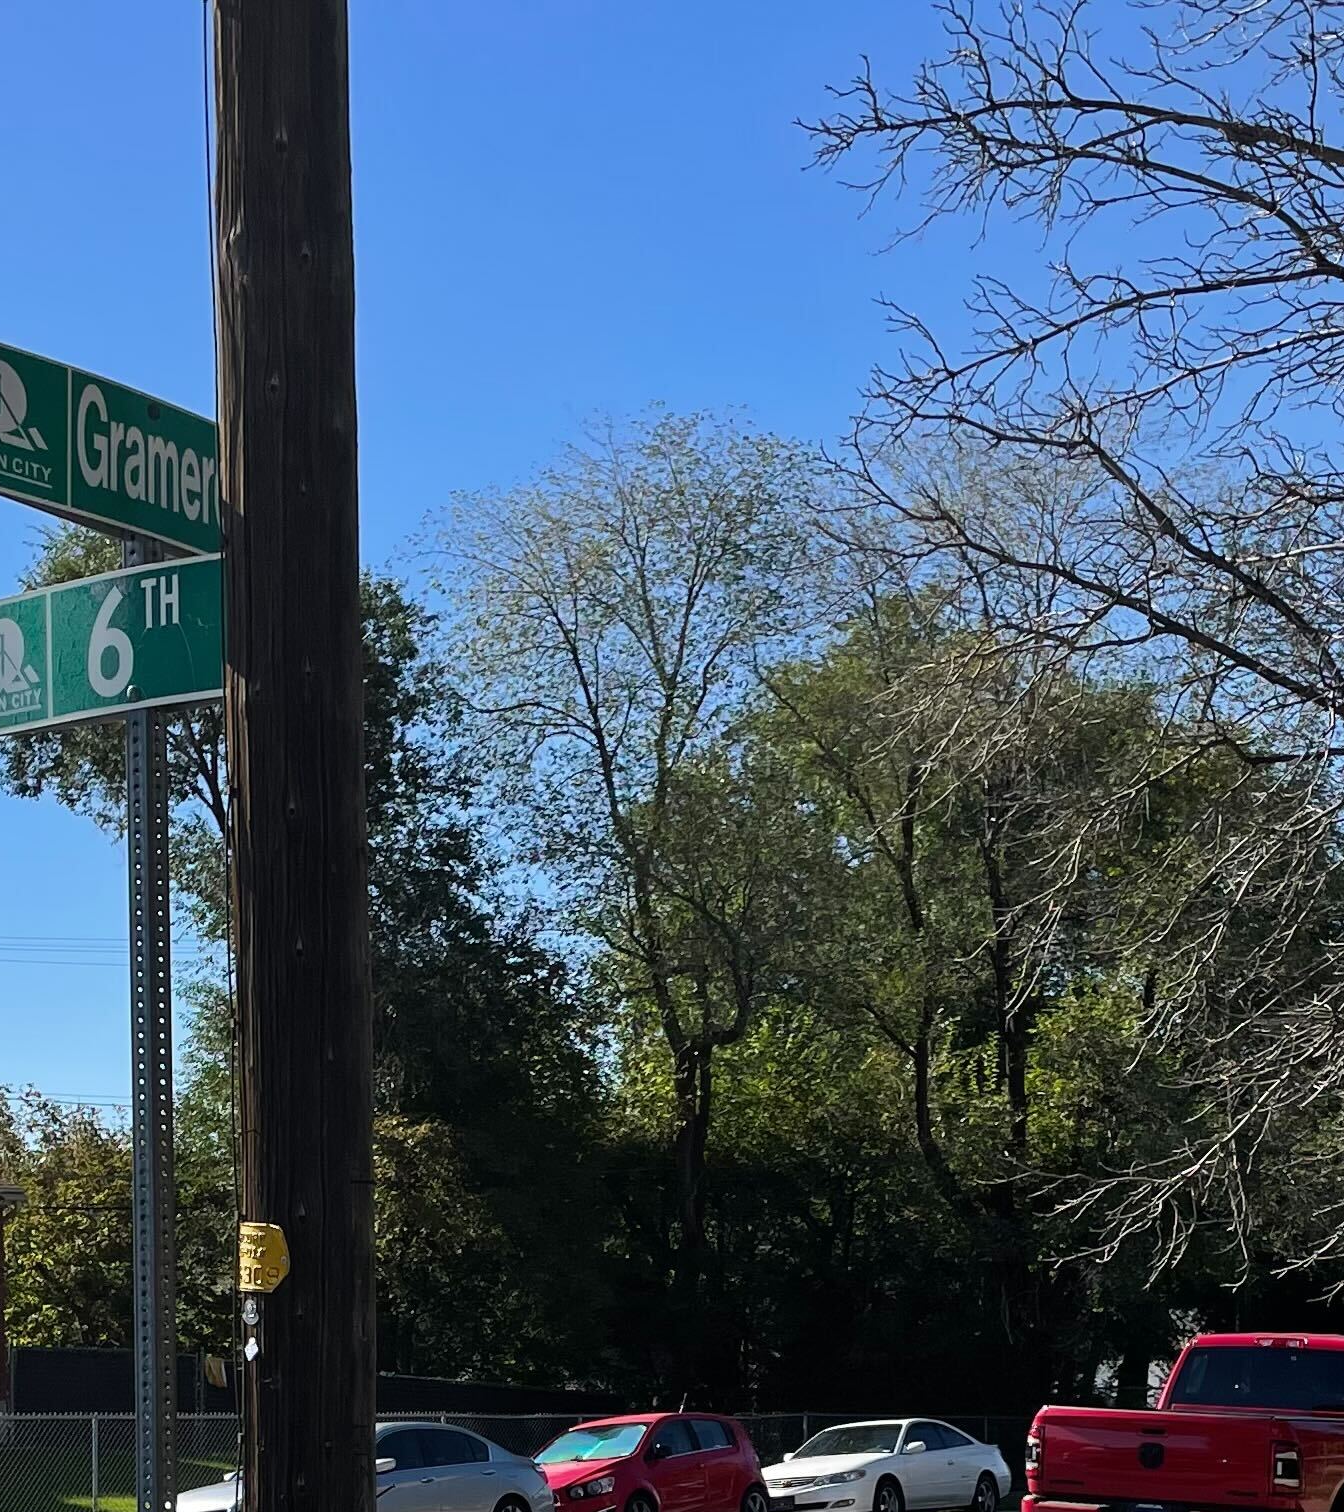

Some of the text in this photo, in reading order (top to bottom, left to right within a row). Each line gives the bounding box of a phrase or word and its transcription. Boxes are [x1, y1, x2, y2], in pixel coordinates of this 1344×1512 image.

[77, 384, 221, 531] Gramer
[12, 458, 52, 482] CITY
[11, 688, 42, 709] CITY
